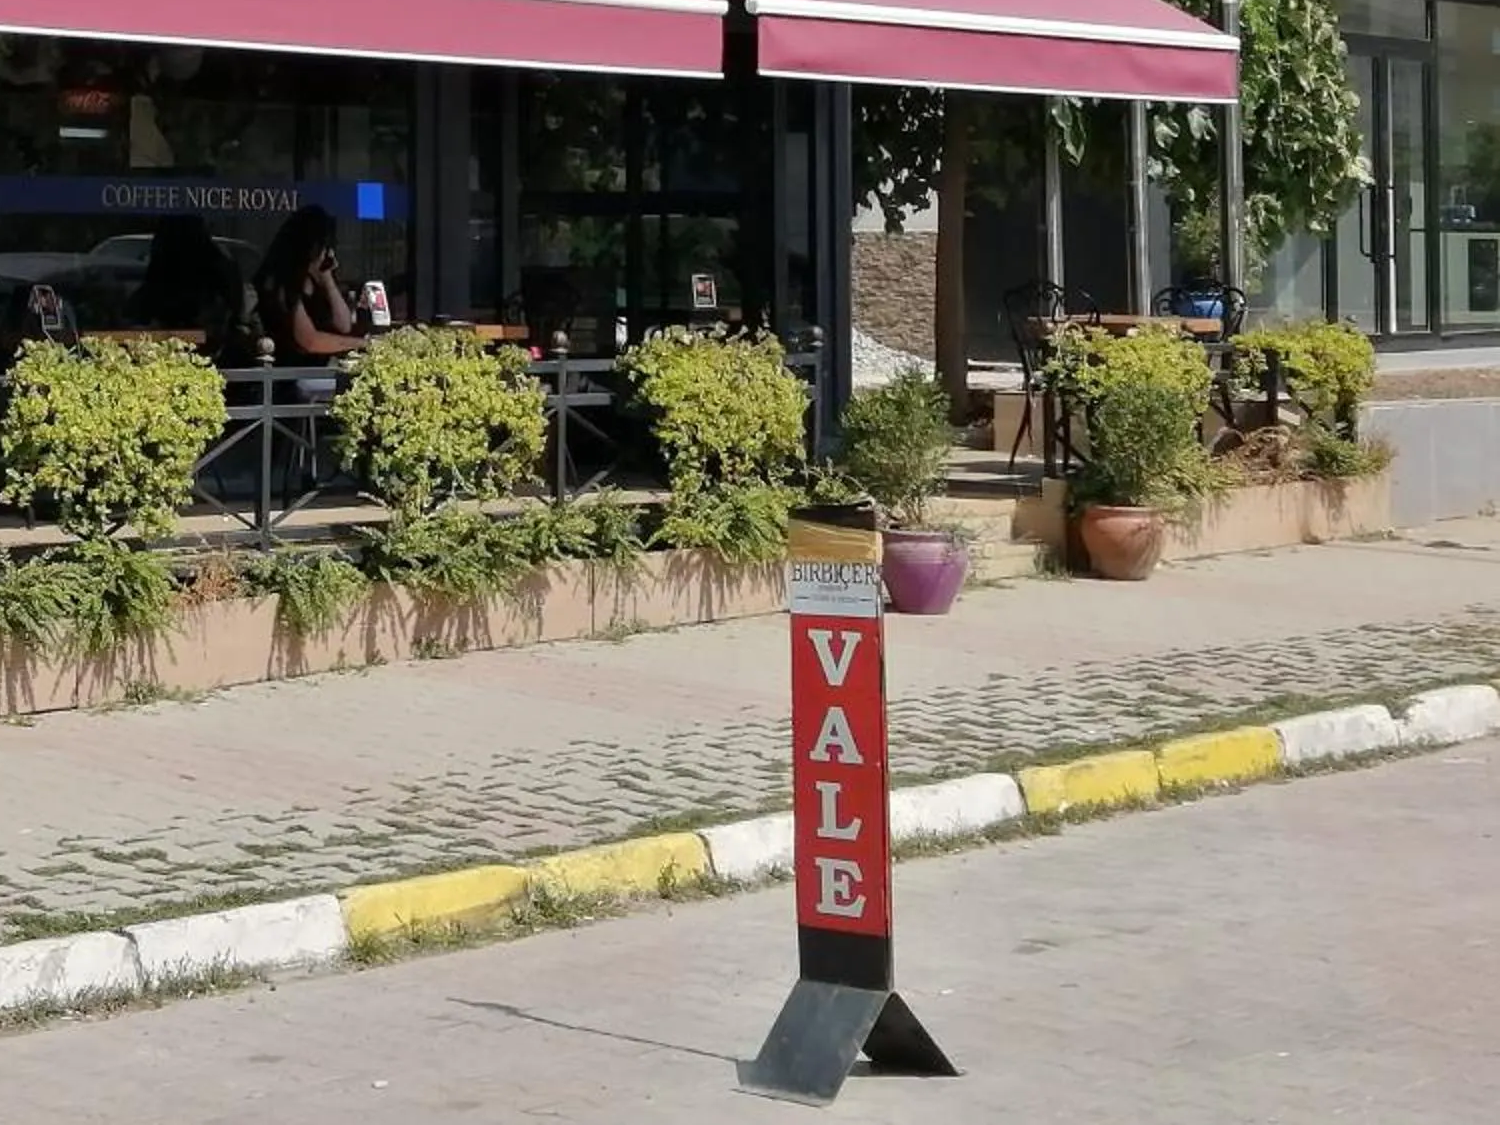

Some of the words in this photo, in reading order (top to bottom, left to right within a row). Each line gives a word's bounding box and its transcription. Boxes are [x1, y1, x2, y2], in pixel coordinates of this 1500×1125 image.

[101, 183, 180, 209] COFFEE
[185, 186, 232, 210] NICE
[806, 628, 867, 919] VALE
